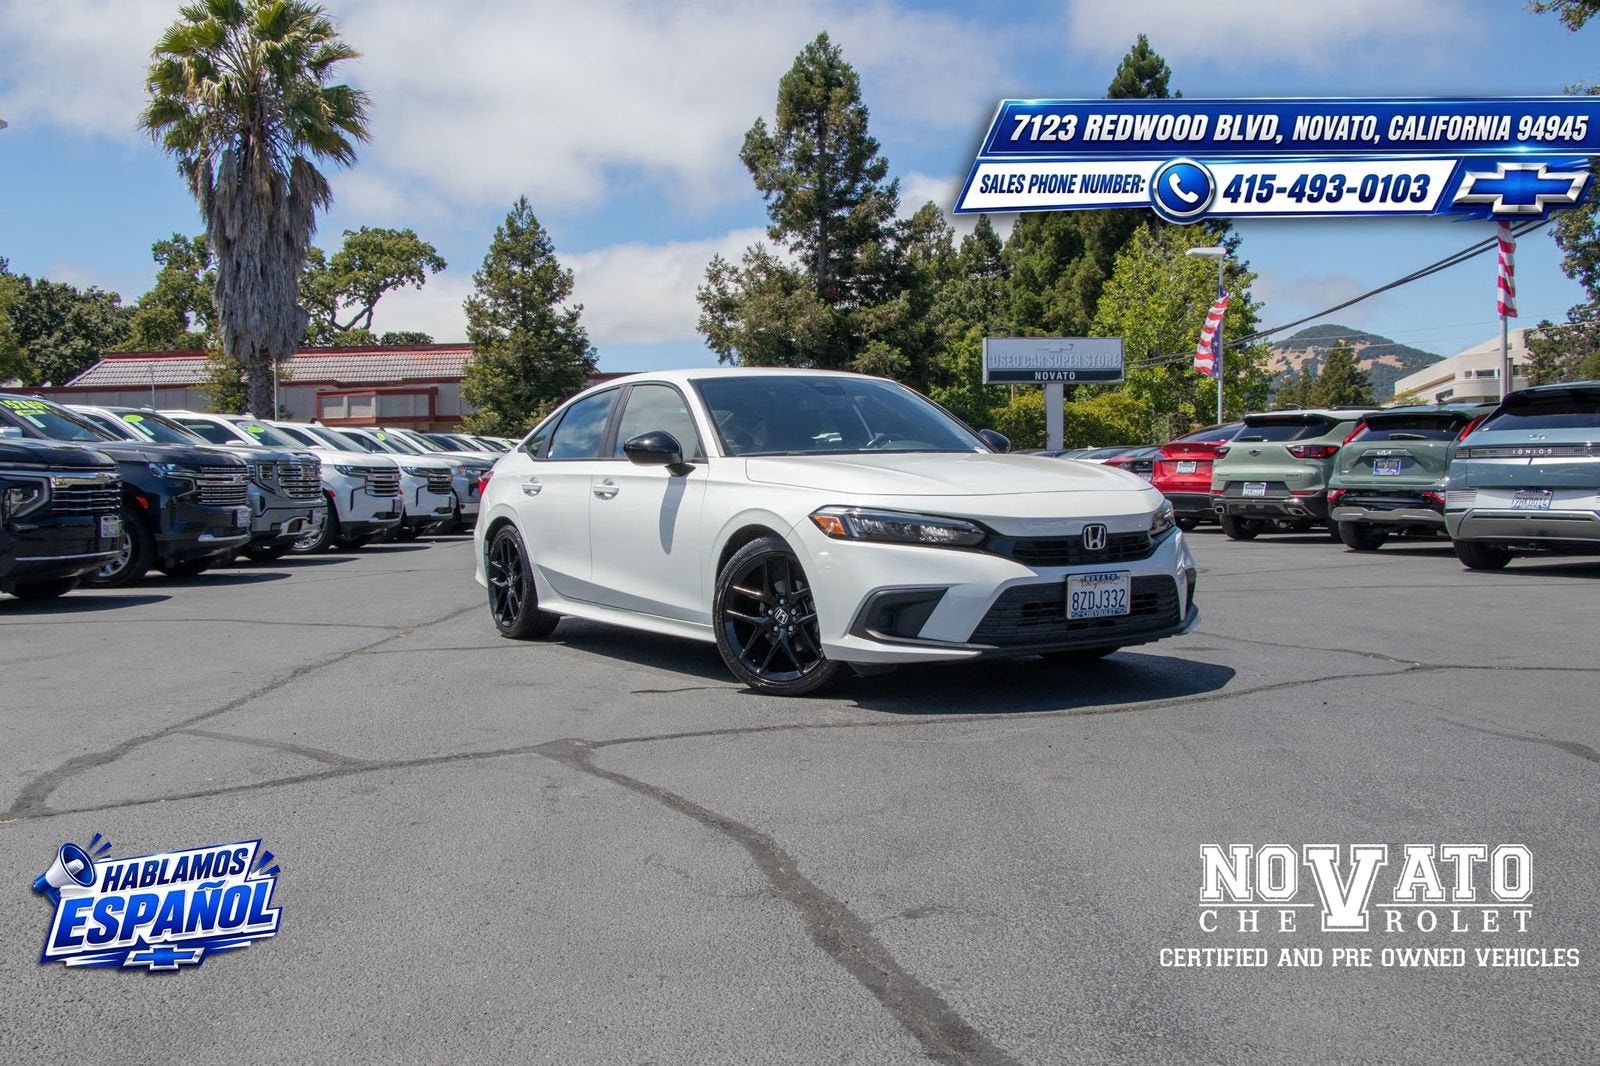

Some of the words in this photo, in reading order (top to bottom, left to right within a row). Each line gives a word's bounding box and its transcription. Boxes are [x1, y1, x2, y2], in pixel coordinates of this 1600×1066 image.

[992, 353, 1020, 368] USED
[1024, 353, 1043, 368] CAR
[1046, 353, 1080, 368] SUPER
[1084, 353, 1120, 368] STORE
[1034, 371, 1076, 381] NOVATO
[1072, 589, 1126, 610] 8ZDJ332
